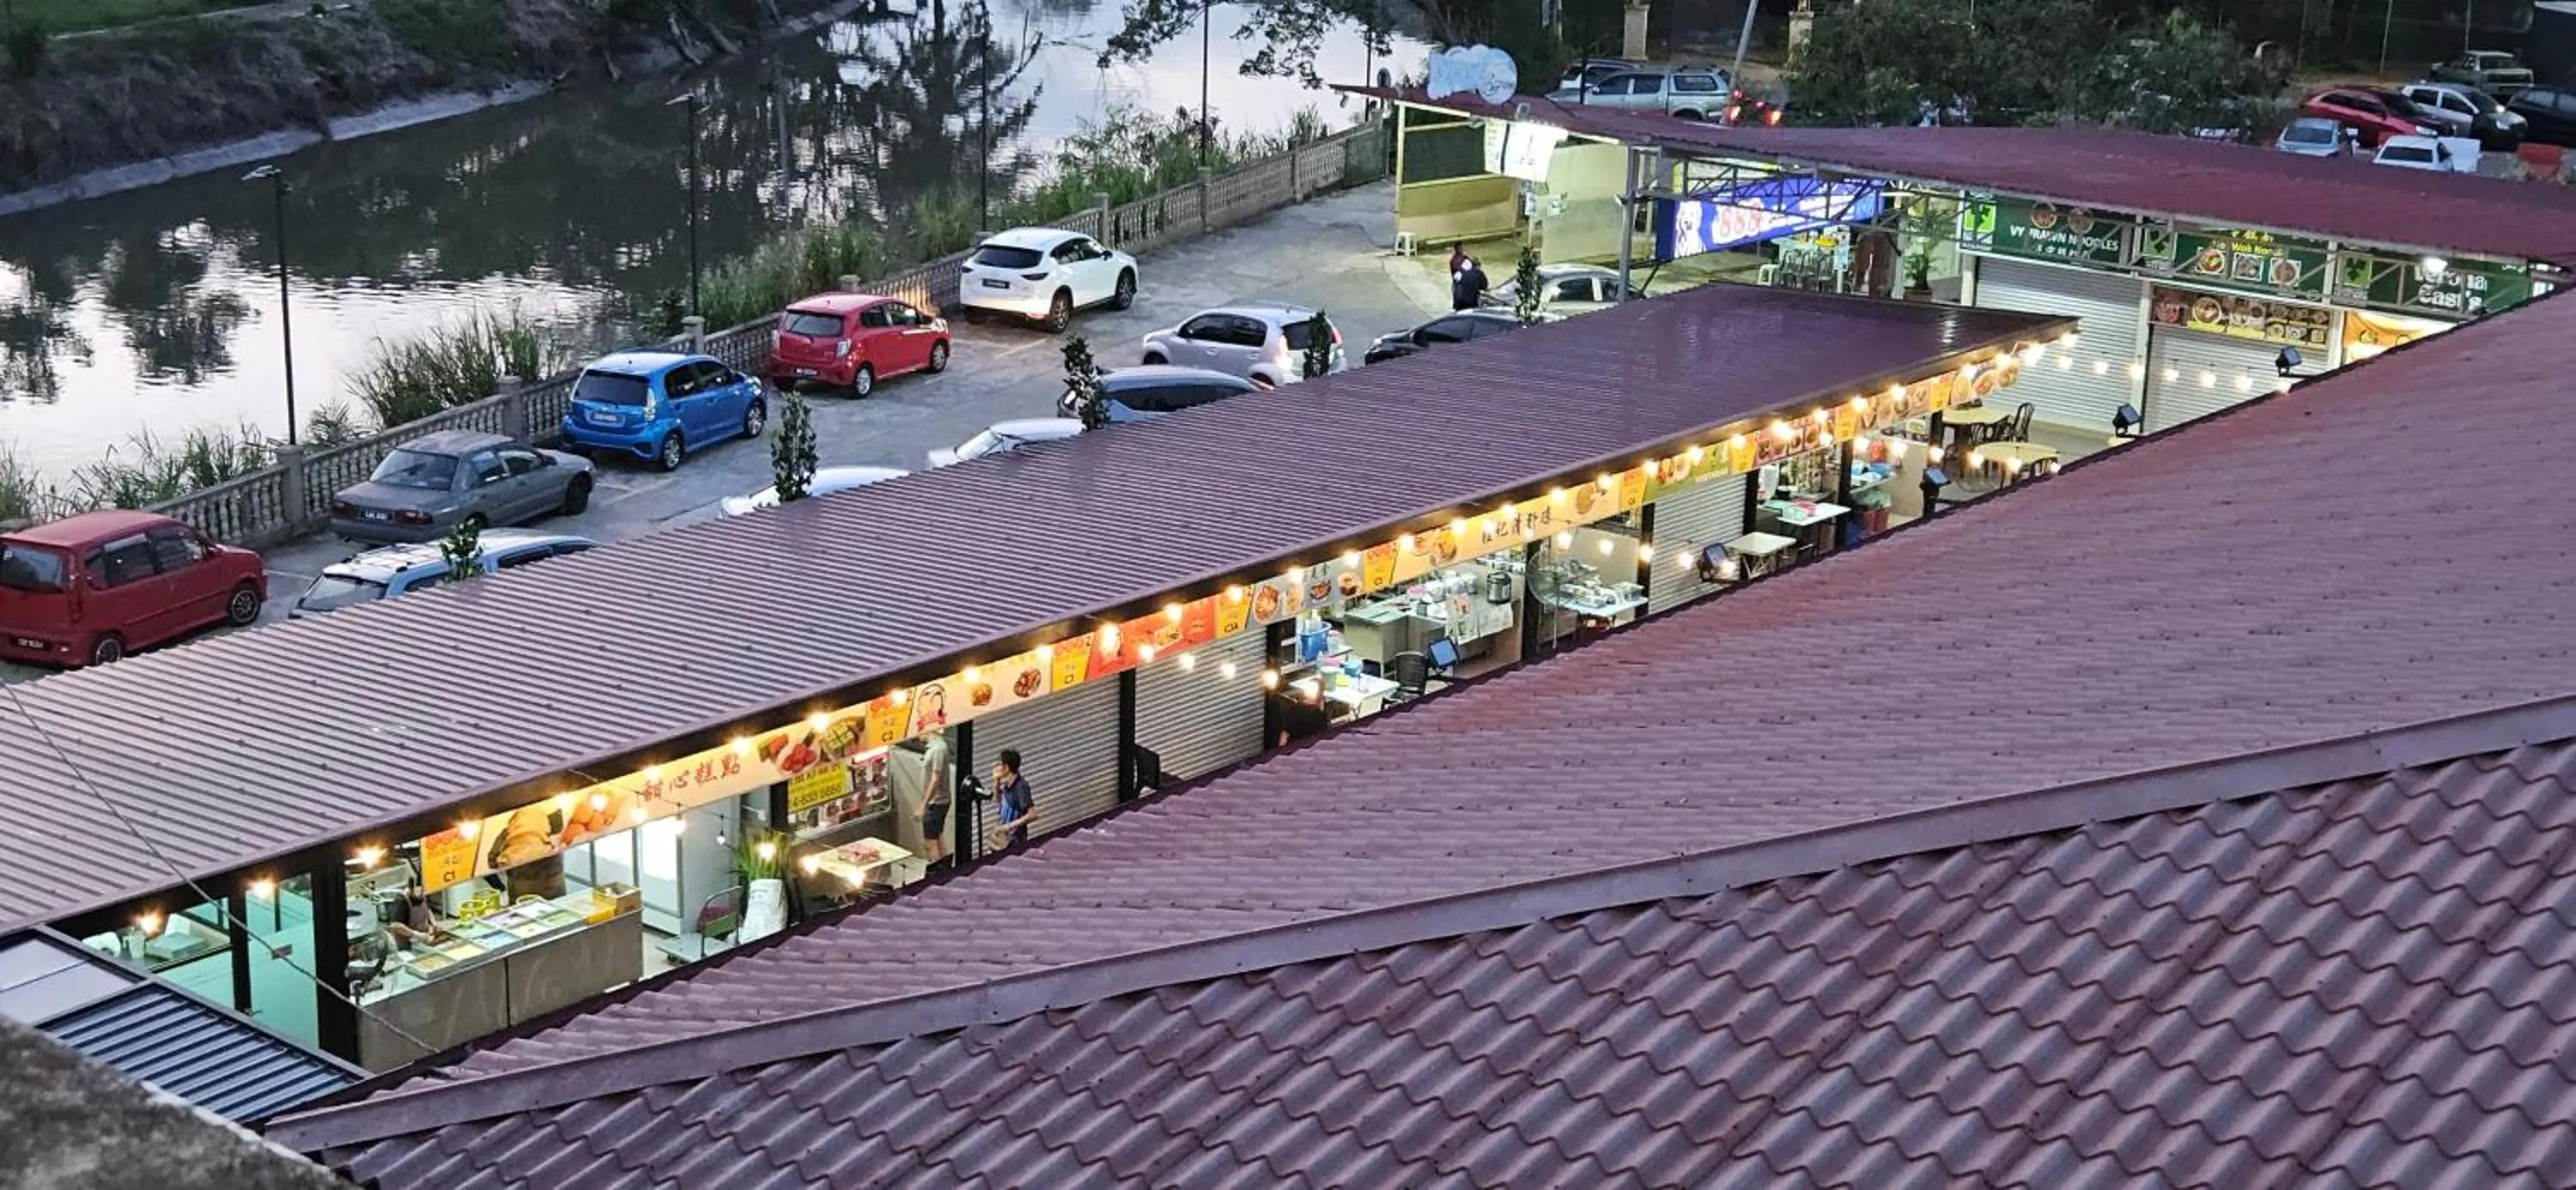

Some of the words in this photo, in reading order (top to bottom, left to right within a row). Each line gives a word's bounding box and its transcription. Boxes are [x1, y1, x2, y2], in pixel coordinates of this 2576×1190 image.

[1720, 201, 1760, 237] 888
[2010, 226, 2025, 237] VY
[2069, 234, 2118, 252] NOLES
[881, 732, 894, 743] C2
